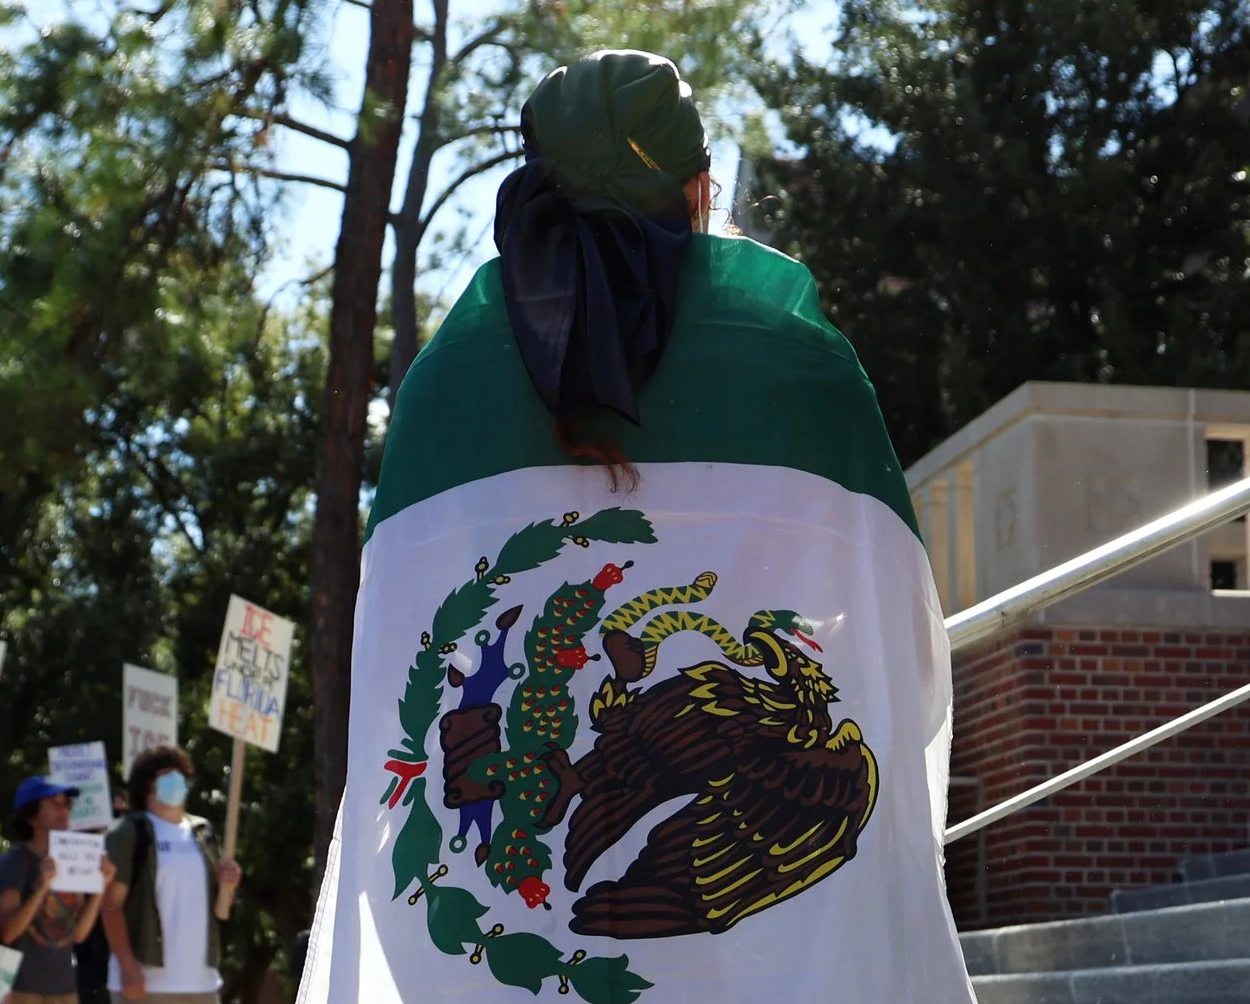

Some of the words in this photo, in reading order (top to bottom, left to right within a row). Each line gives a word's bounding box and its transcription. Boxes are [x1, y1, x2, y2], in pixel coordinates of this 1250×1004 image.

[240, 604, 273, 648] ICE
[225, 630, 285, 681] MELTS
[218, 696, 273, 742] HEAT
